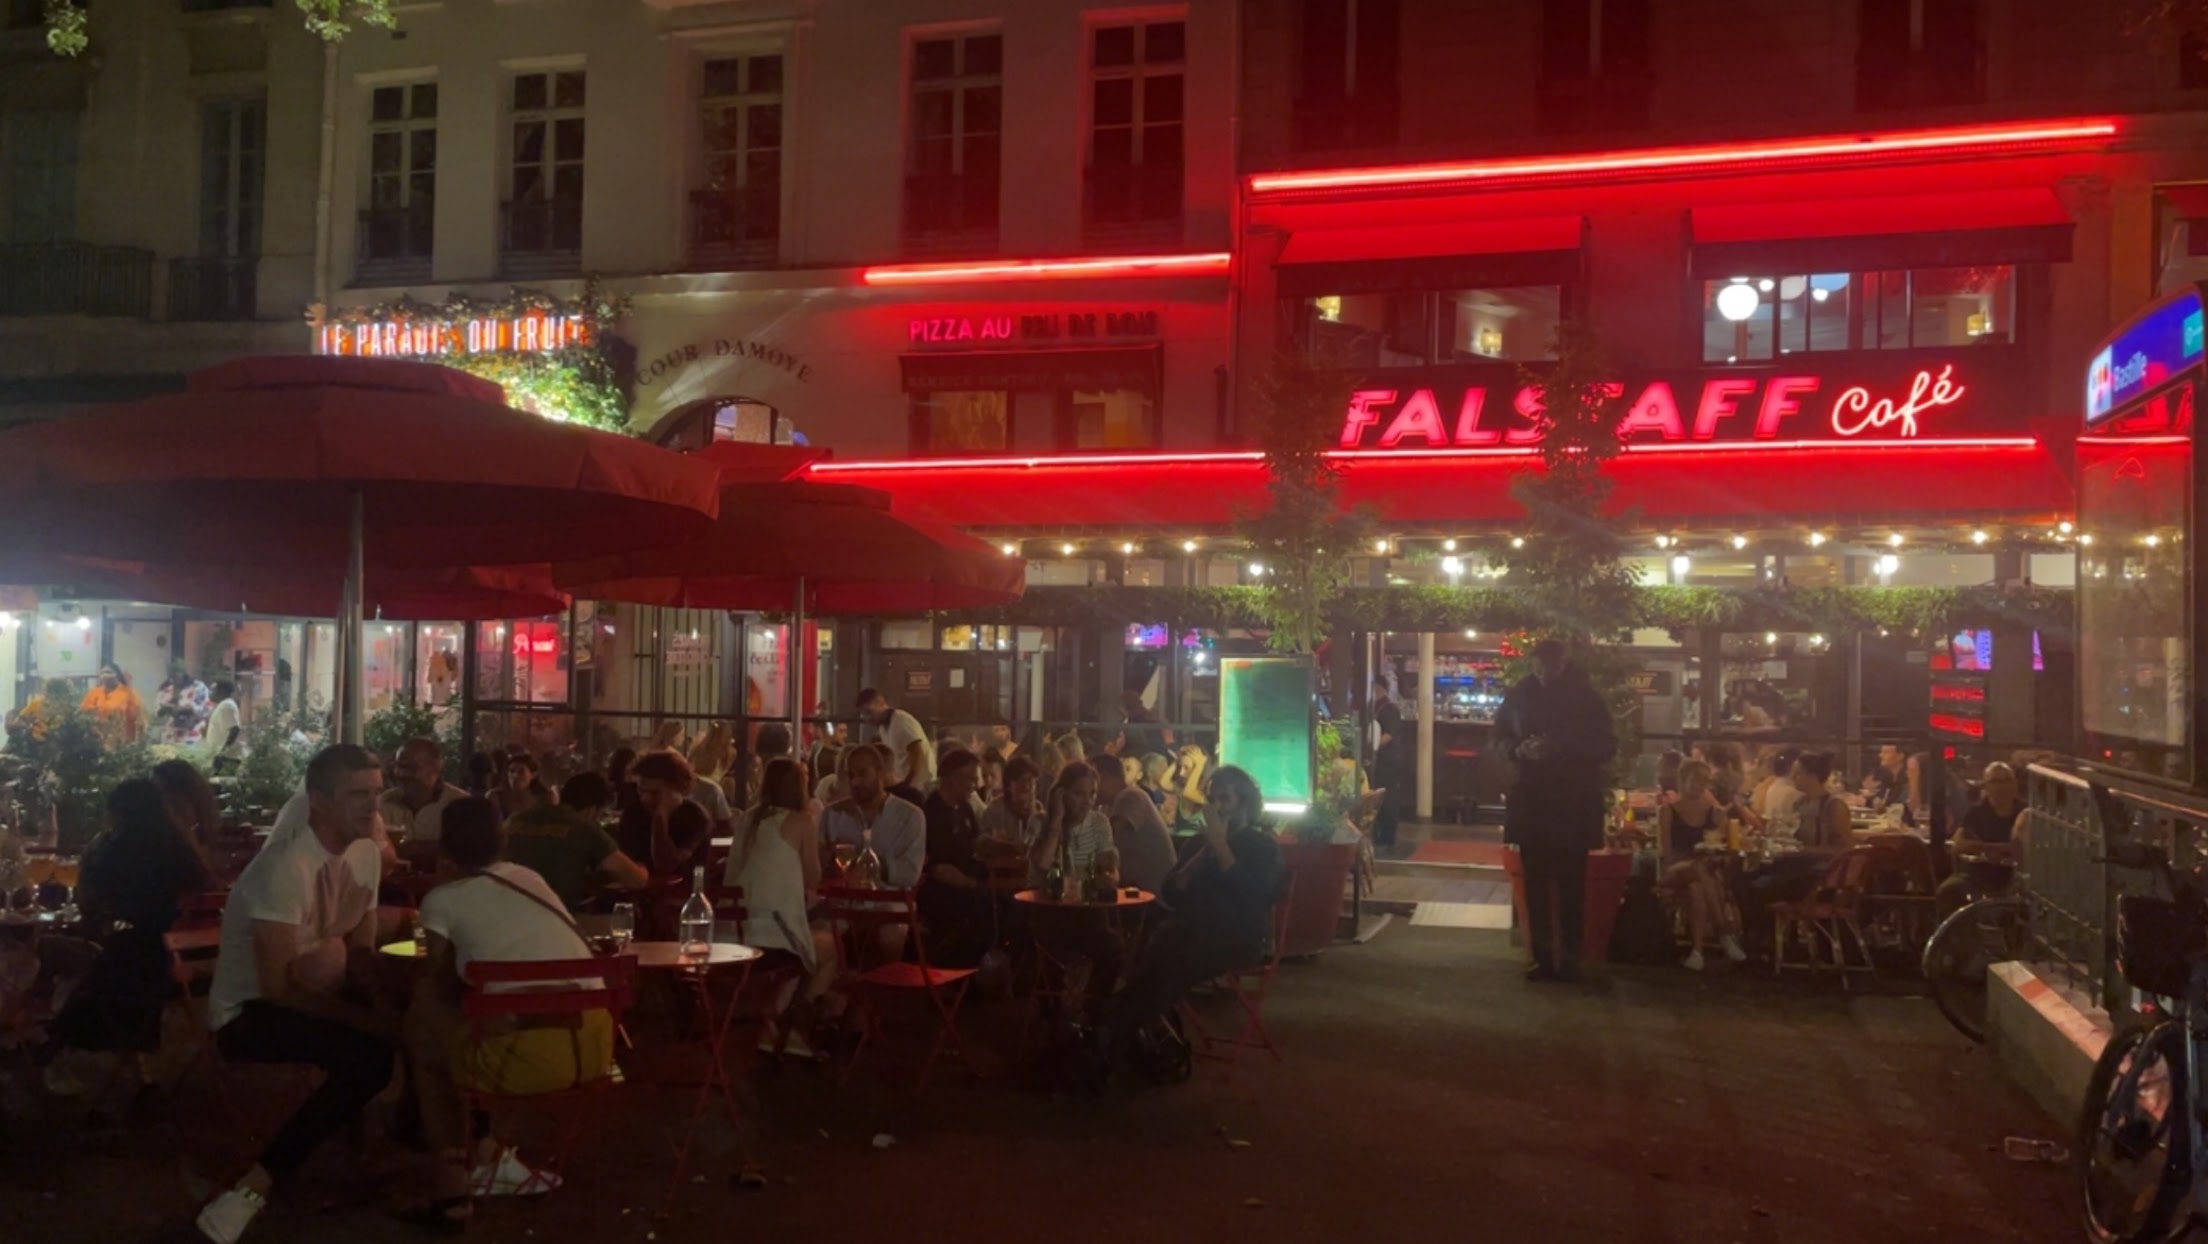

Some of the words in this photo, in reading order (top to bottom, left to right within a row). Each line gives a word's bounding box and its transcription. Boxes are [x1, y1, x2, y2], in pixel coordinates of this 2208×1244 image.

[513, 315, 583, 351] FRUIT
[909, 319, 974, 341] PIZZA
[980, 317, 1012, 340] AU
[637, 343, 700, 386] COUR
[714, 339, 813, 383] DAMOYE
[1339, 375, 1820, 448] FALSAFF
[1831, 364, 1965, 437] Café
